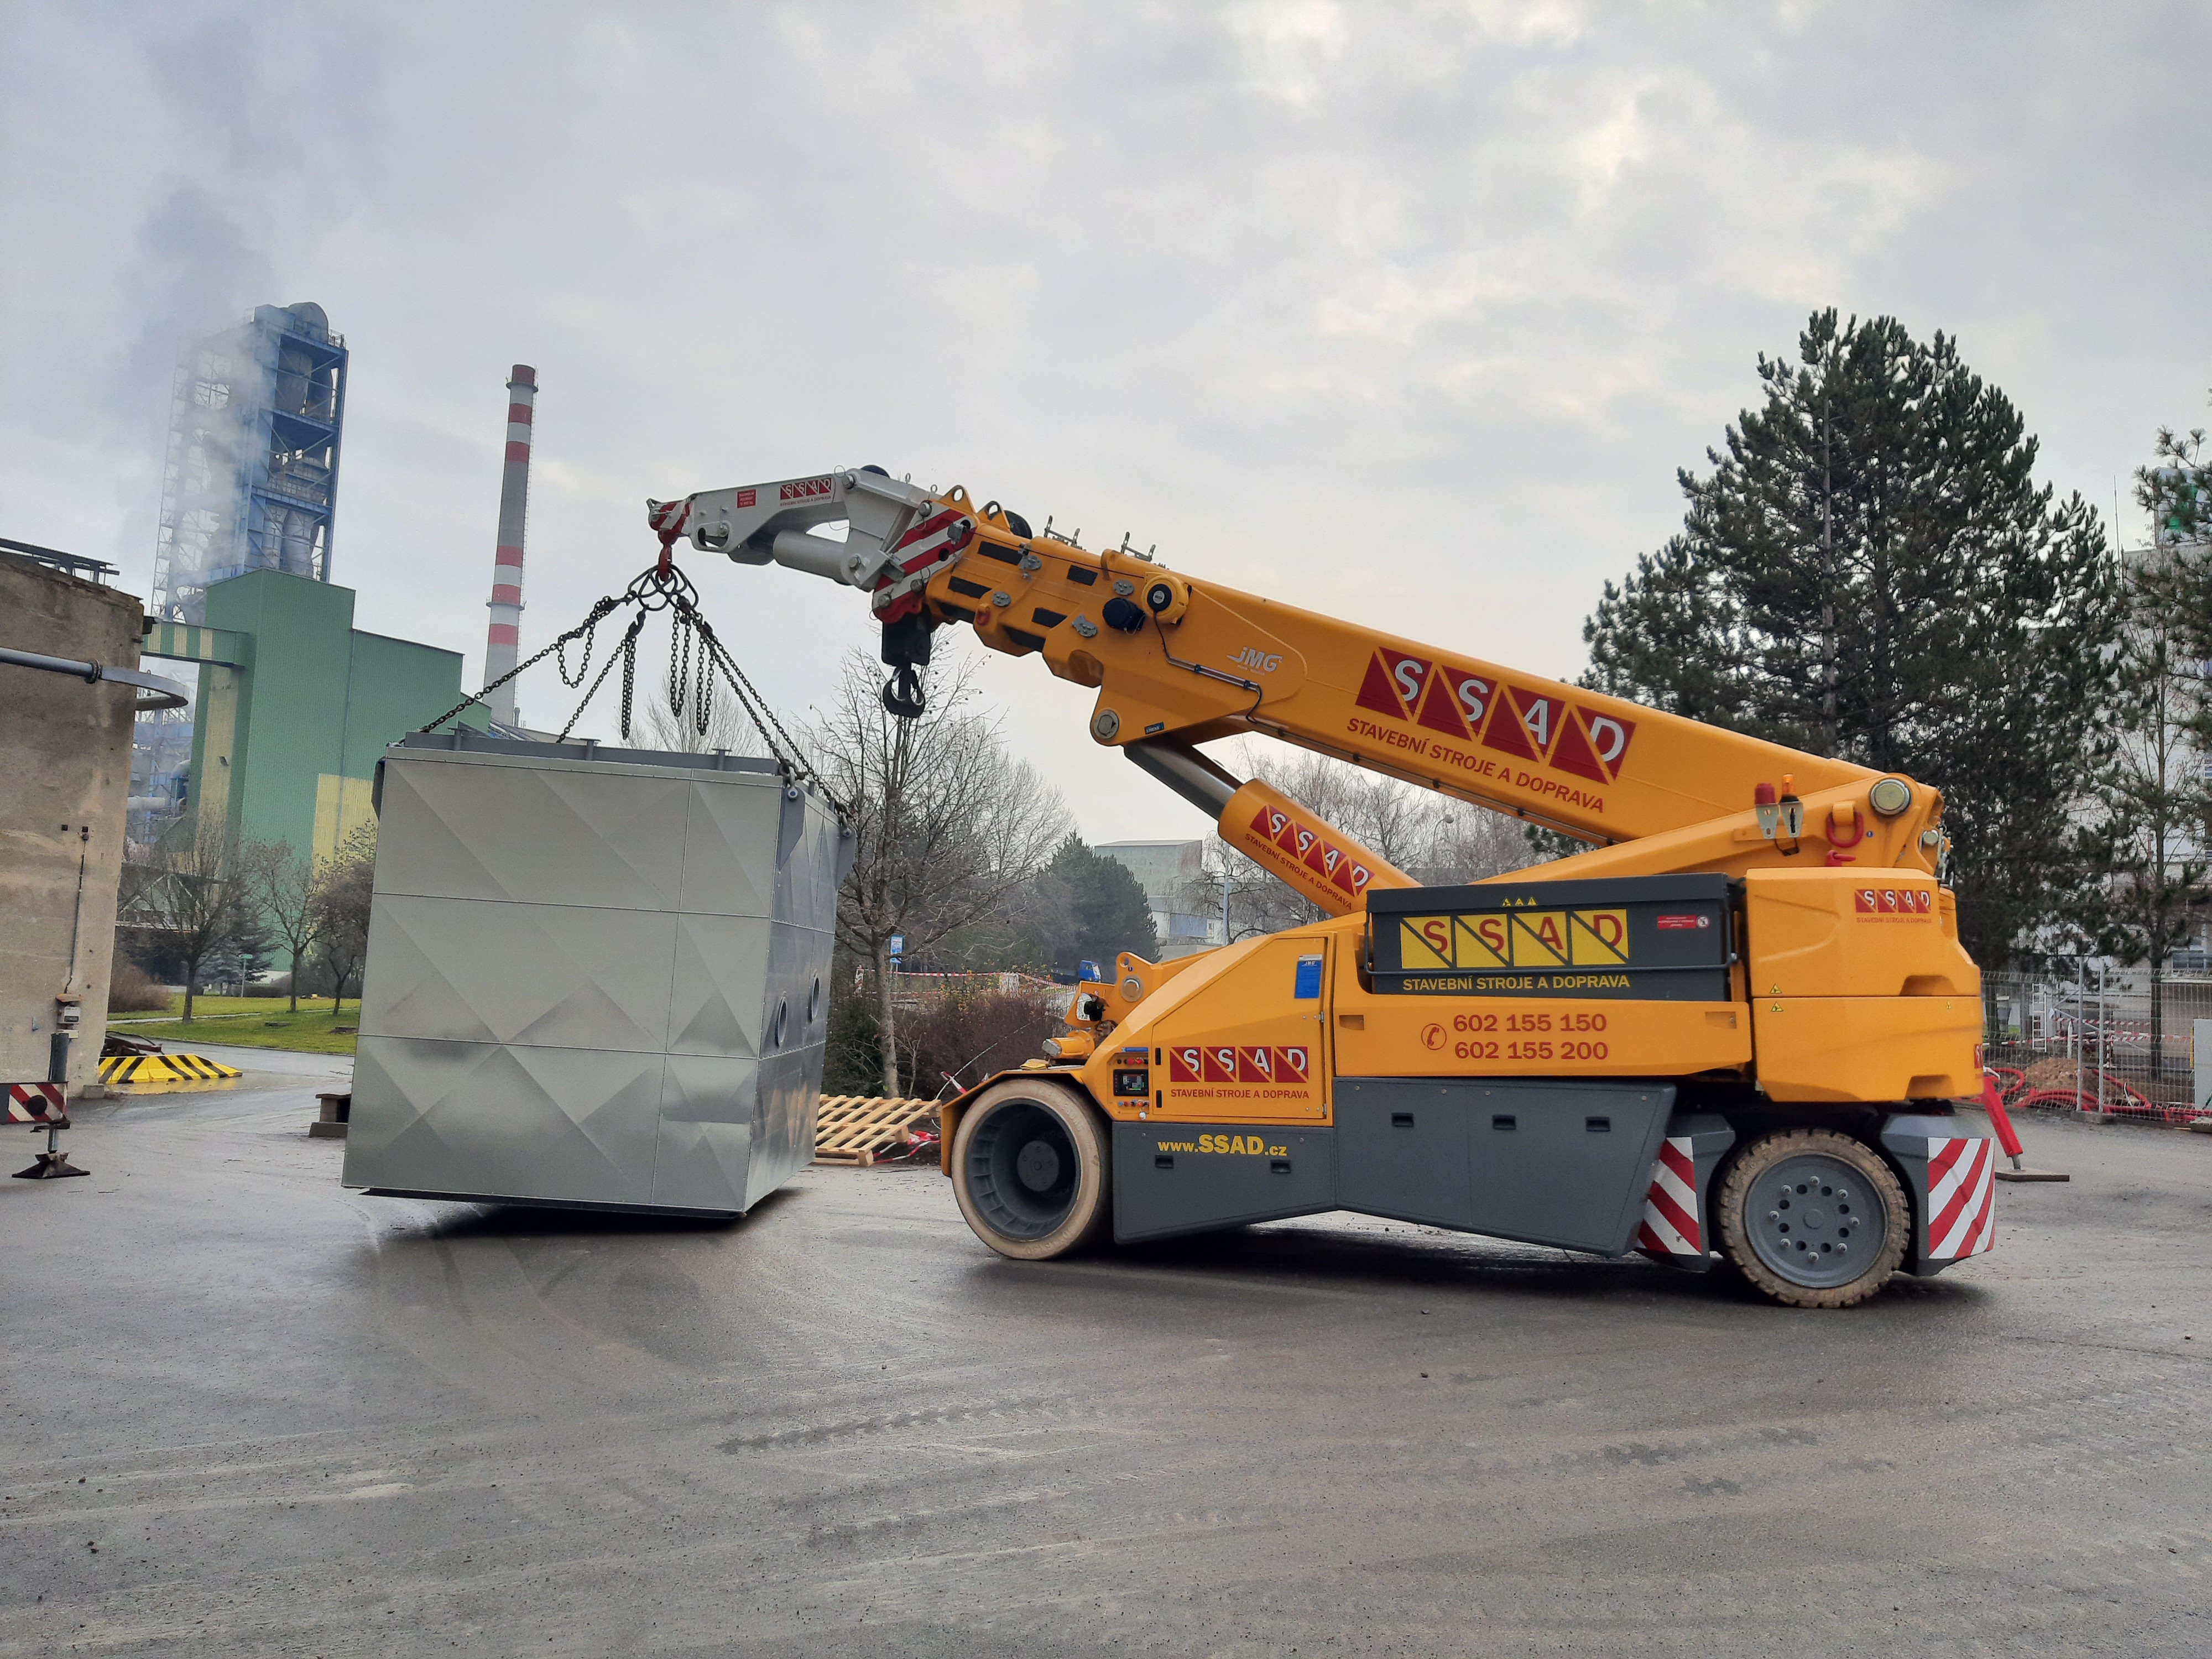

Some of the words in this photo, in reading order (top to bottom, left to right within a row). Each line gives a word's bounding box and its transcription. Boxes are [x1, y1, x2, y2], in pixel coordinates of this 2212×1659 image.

[785, 478, 831, 495] SSAD
[1394, 659, 1625, 763] SSAD
[1346, 718, 1430, 755] STAVEBNÍ
[1430, 744, 1496, 778] STROJE
[1497, 767, 1511, 782] A
[1515, 771, 1604, 813] DOPRAVA
[1271, 813, 1369, 887] SSAD
[1245, 833, 1281, 860] STAVEBNÍ
[1280, 857, 1309, 880] STROJE
[1308, 877, 1314, 885] A
[1316, 880, 1352, 910] DOPRAVA
[1864, 890, 1930, 907] SSAD
[1423, 914, 1623, 953] SSAD
[1403, 975, 1472, 990] STAVEBNÍ
[1477, 976, 1533, 990] STROJE
[1537, 975, 1548, 989] A
[1553, 975, 1630, 989] DOPRAVA
[1453, 1014, 1498, 1032] 602
[1506, 1014, 1551, 1032] 155
[1560, 1013, 1607, 1032] 150
[1183, 1048, 1306, 1072] SSAD
[1454, 1041, 1499, 1060] 602
[1507, 1041, 1553, 1060] 155
[1561, 1041, 1609, 1060] 200
[1171, 1087, 1214, 1098] STAVEBNÍ
[1216, 1089, 1251, 1098] STROJE
[1254, 1090, 1260, 1098] A
[1263, 1090, 1310, 1099] DOPRAVA
[1157, 1134, 1288, 1156] www.SSAD.cz
